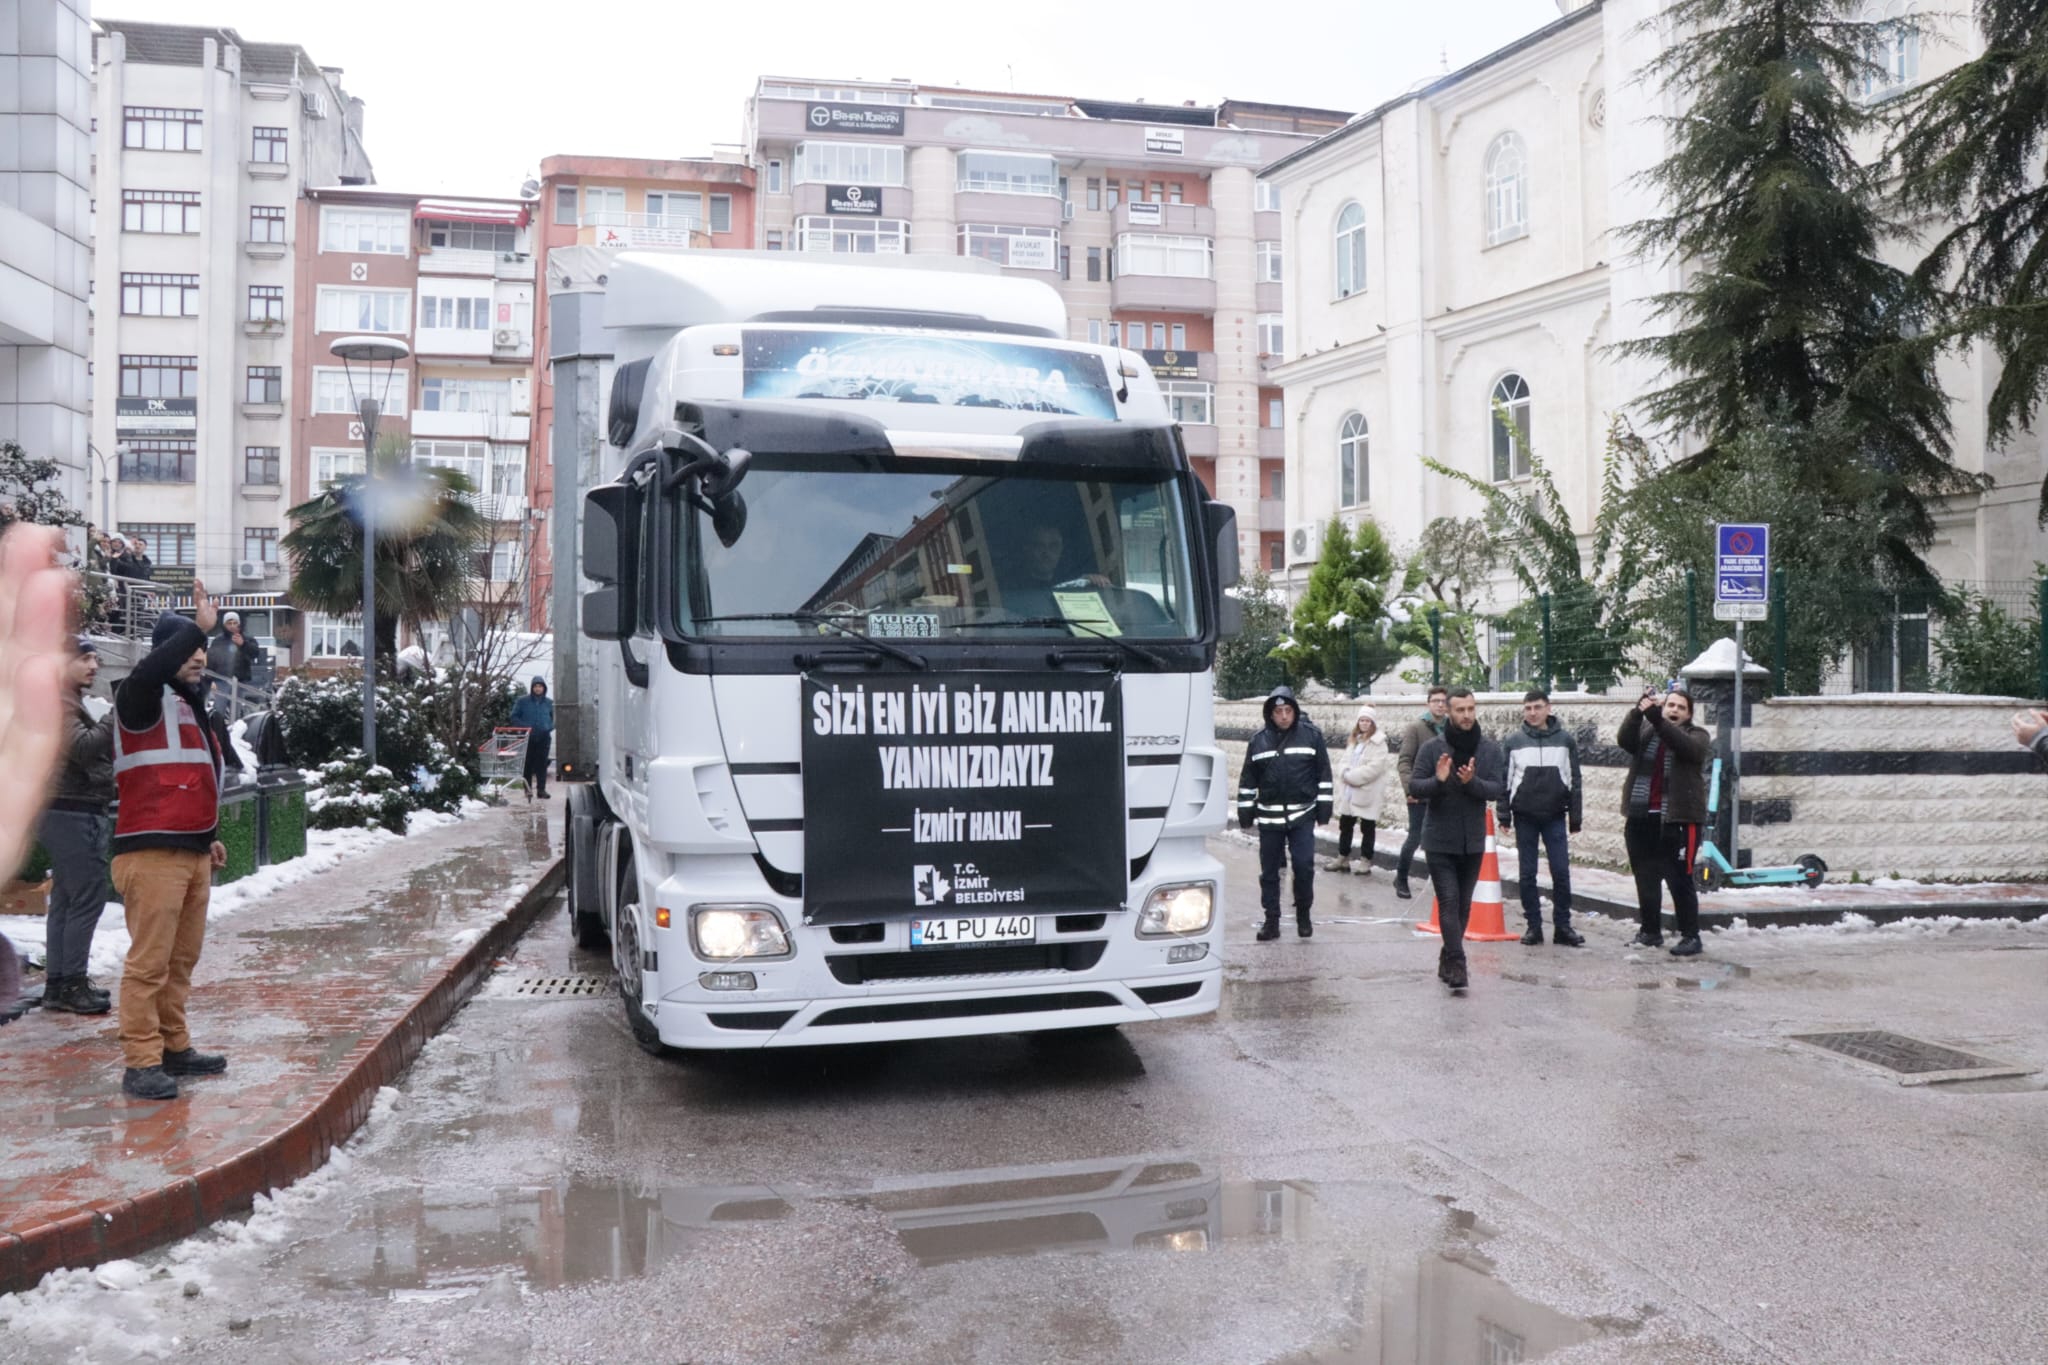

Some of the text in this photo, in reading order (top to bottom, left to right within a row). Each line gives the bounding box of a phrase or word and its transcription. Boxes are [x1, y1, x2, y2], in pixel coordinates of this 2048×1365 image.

[871, 615, 936, 624] MURAT
[813, 683, 1112, 736] SİZİ EN İYİ BİZ ANLARIZ.
[878, 744, 1054, 789] YANINIZDAYIZ
[914, 807, 1022, 843] İZMİT HALKI
[953, 863, 979, 875] T.C.
[954, 874, 990, 889] İZMİT
[955, 887, 1025, 904] BELEDİYESİ
[924, 921, 948, 941] 41
[957, 918, 986, 940] PU
[995, 916, 1031, 937] 440
